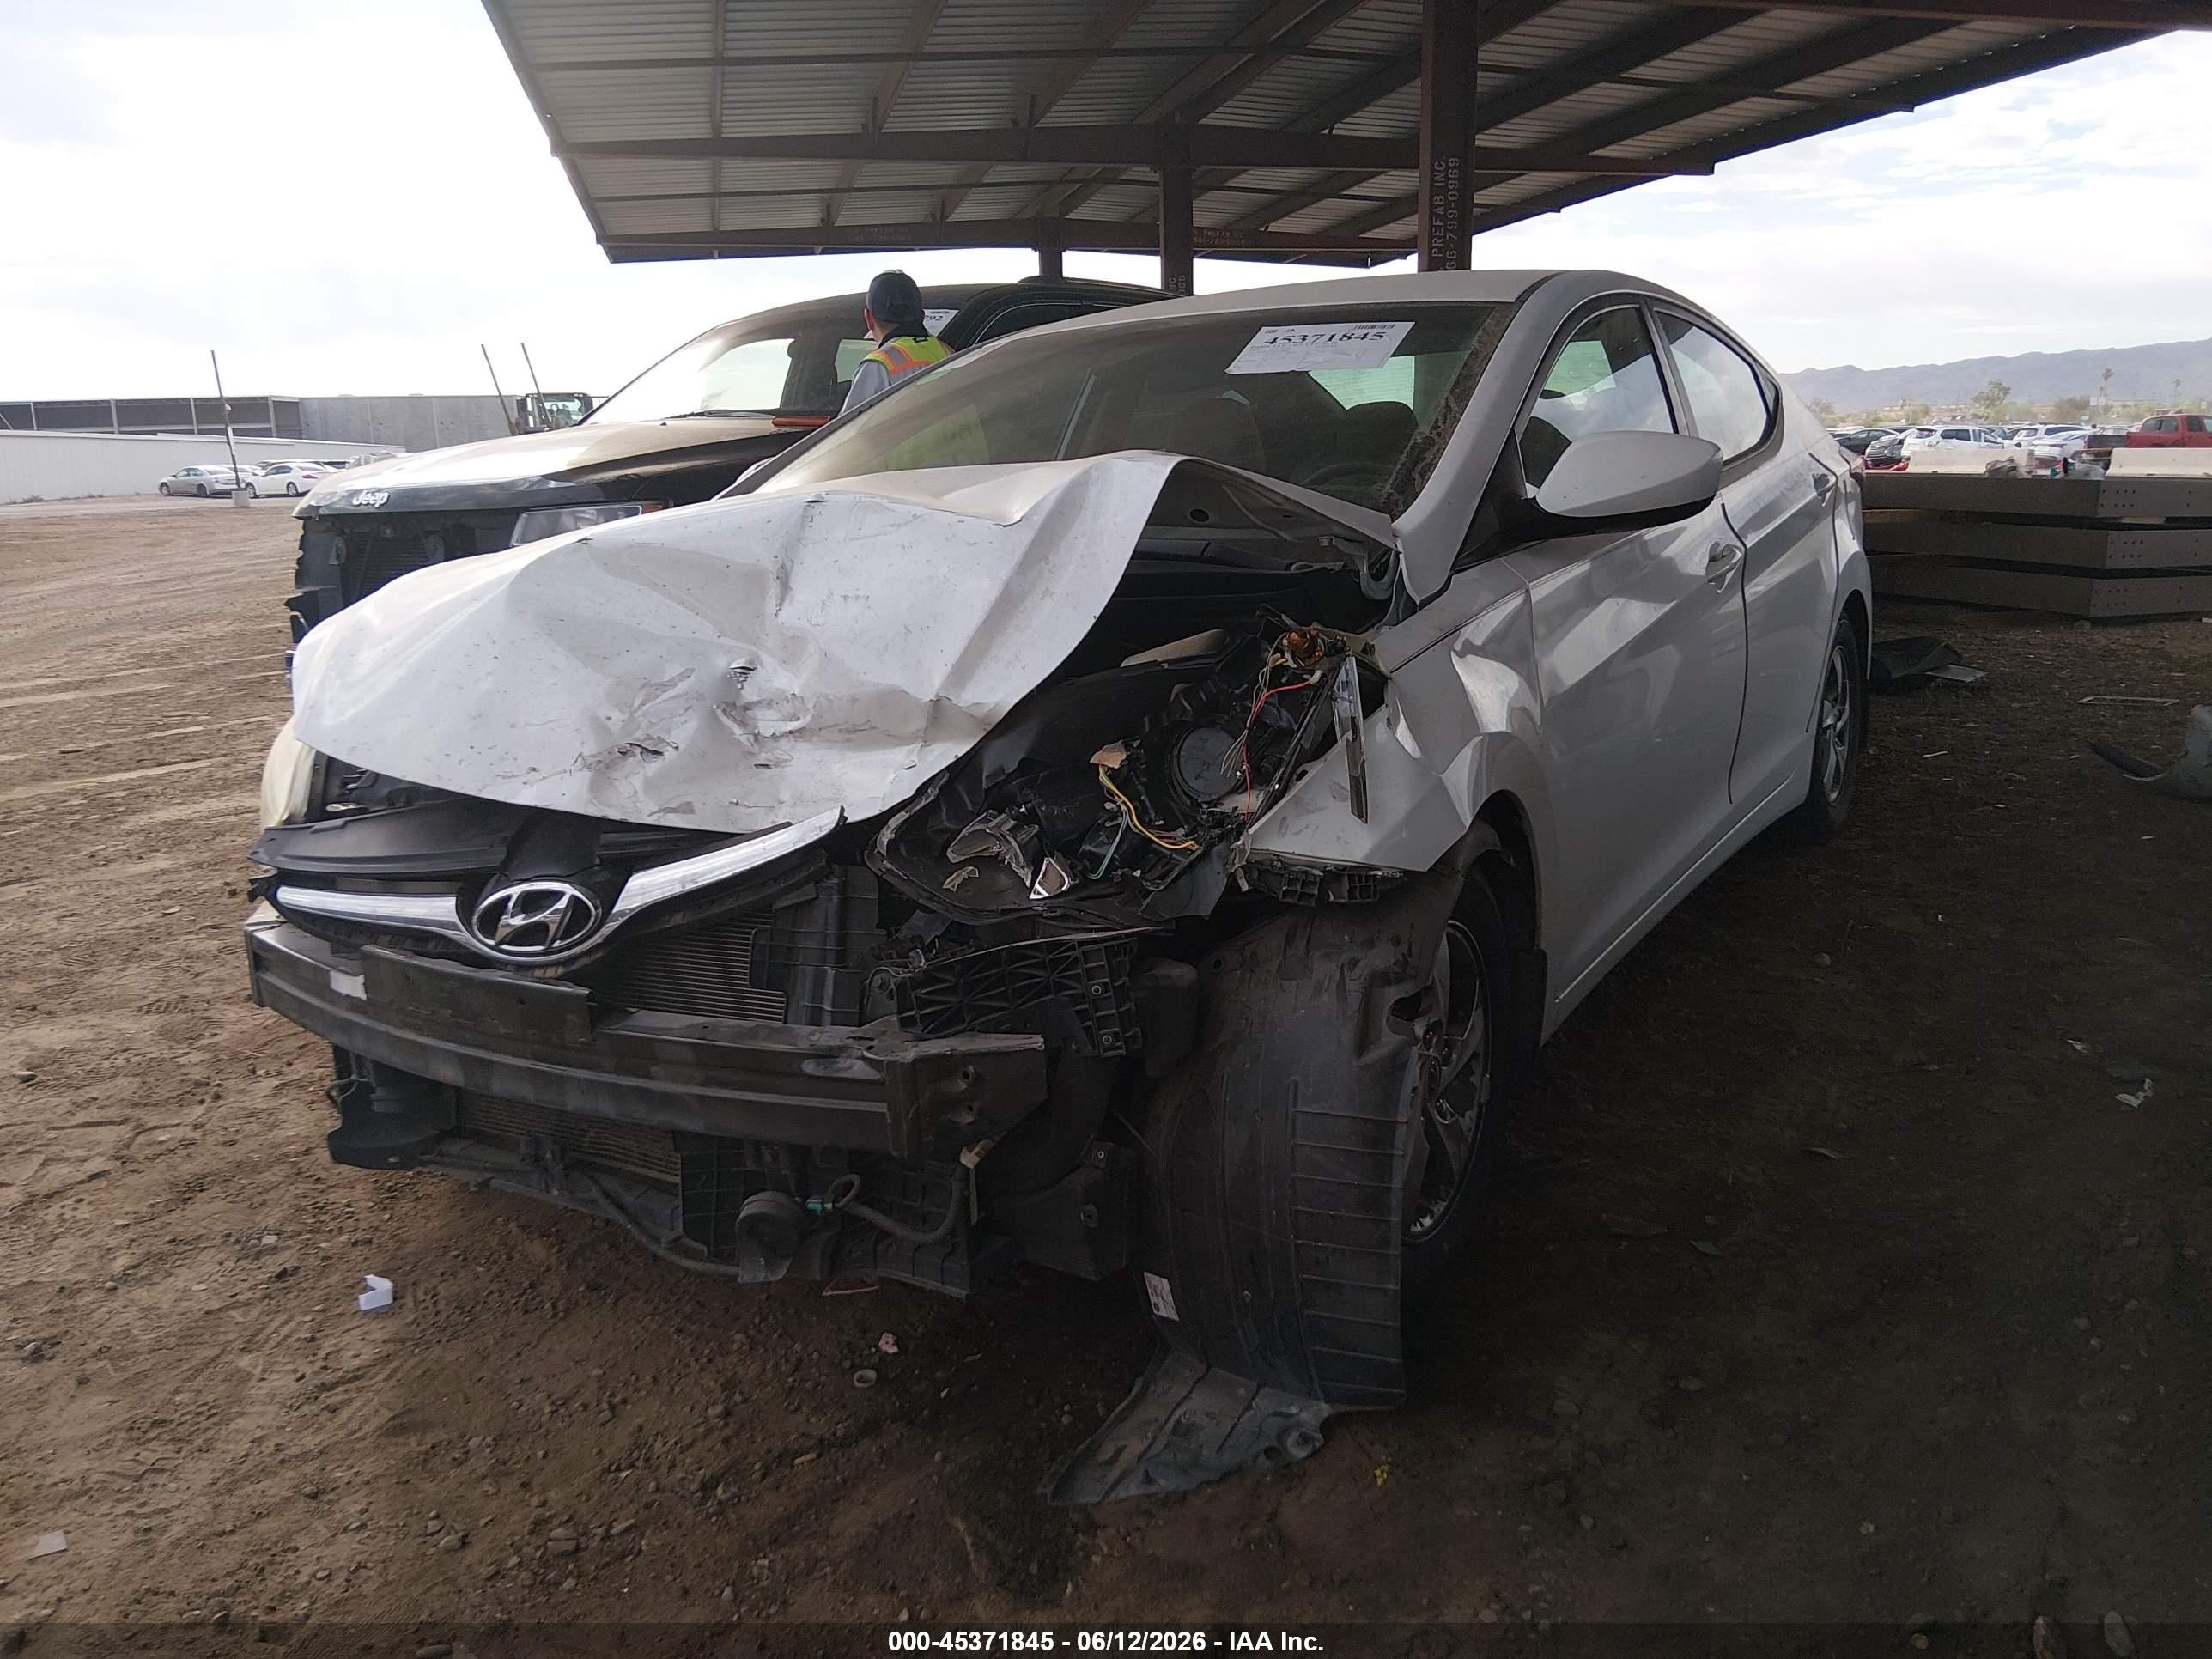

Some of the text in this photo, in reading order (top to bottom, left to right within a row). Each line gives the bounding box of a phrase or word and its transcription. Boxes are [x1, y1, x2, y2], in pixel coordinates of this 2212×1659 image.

[1431, 195, 1444, 258] PREFAB
[1263, 331, 1387, 345] 45371845
[352, 489, 390, 508] Jeep
